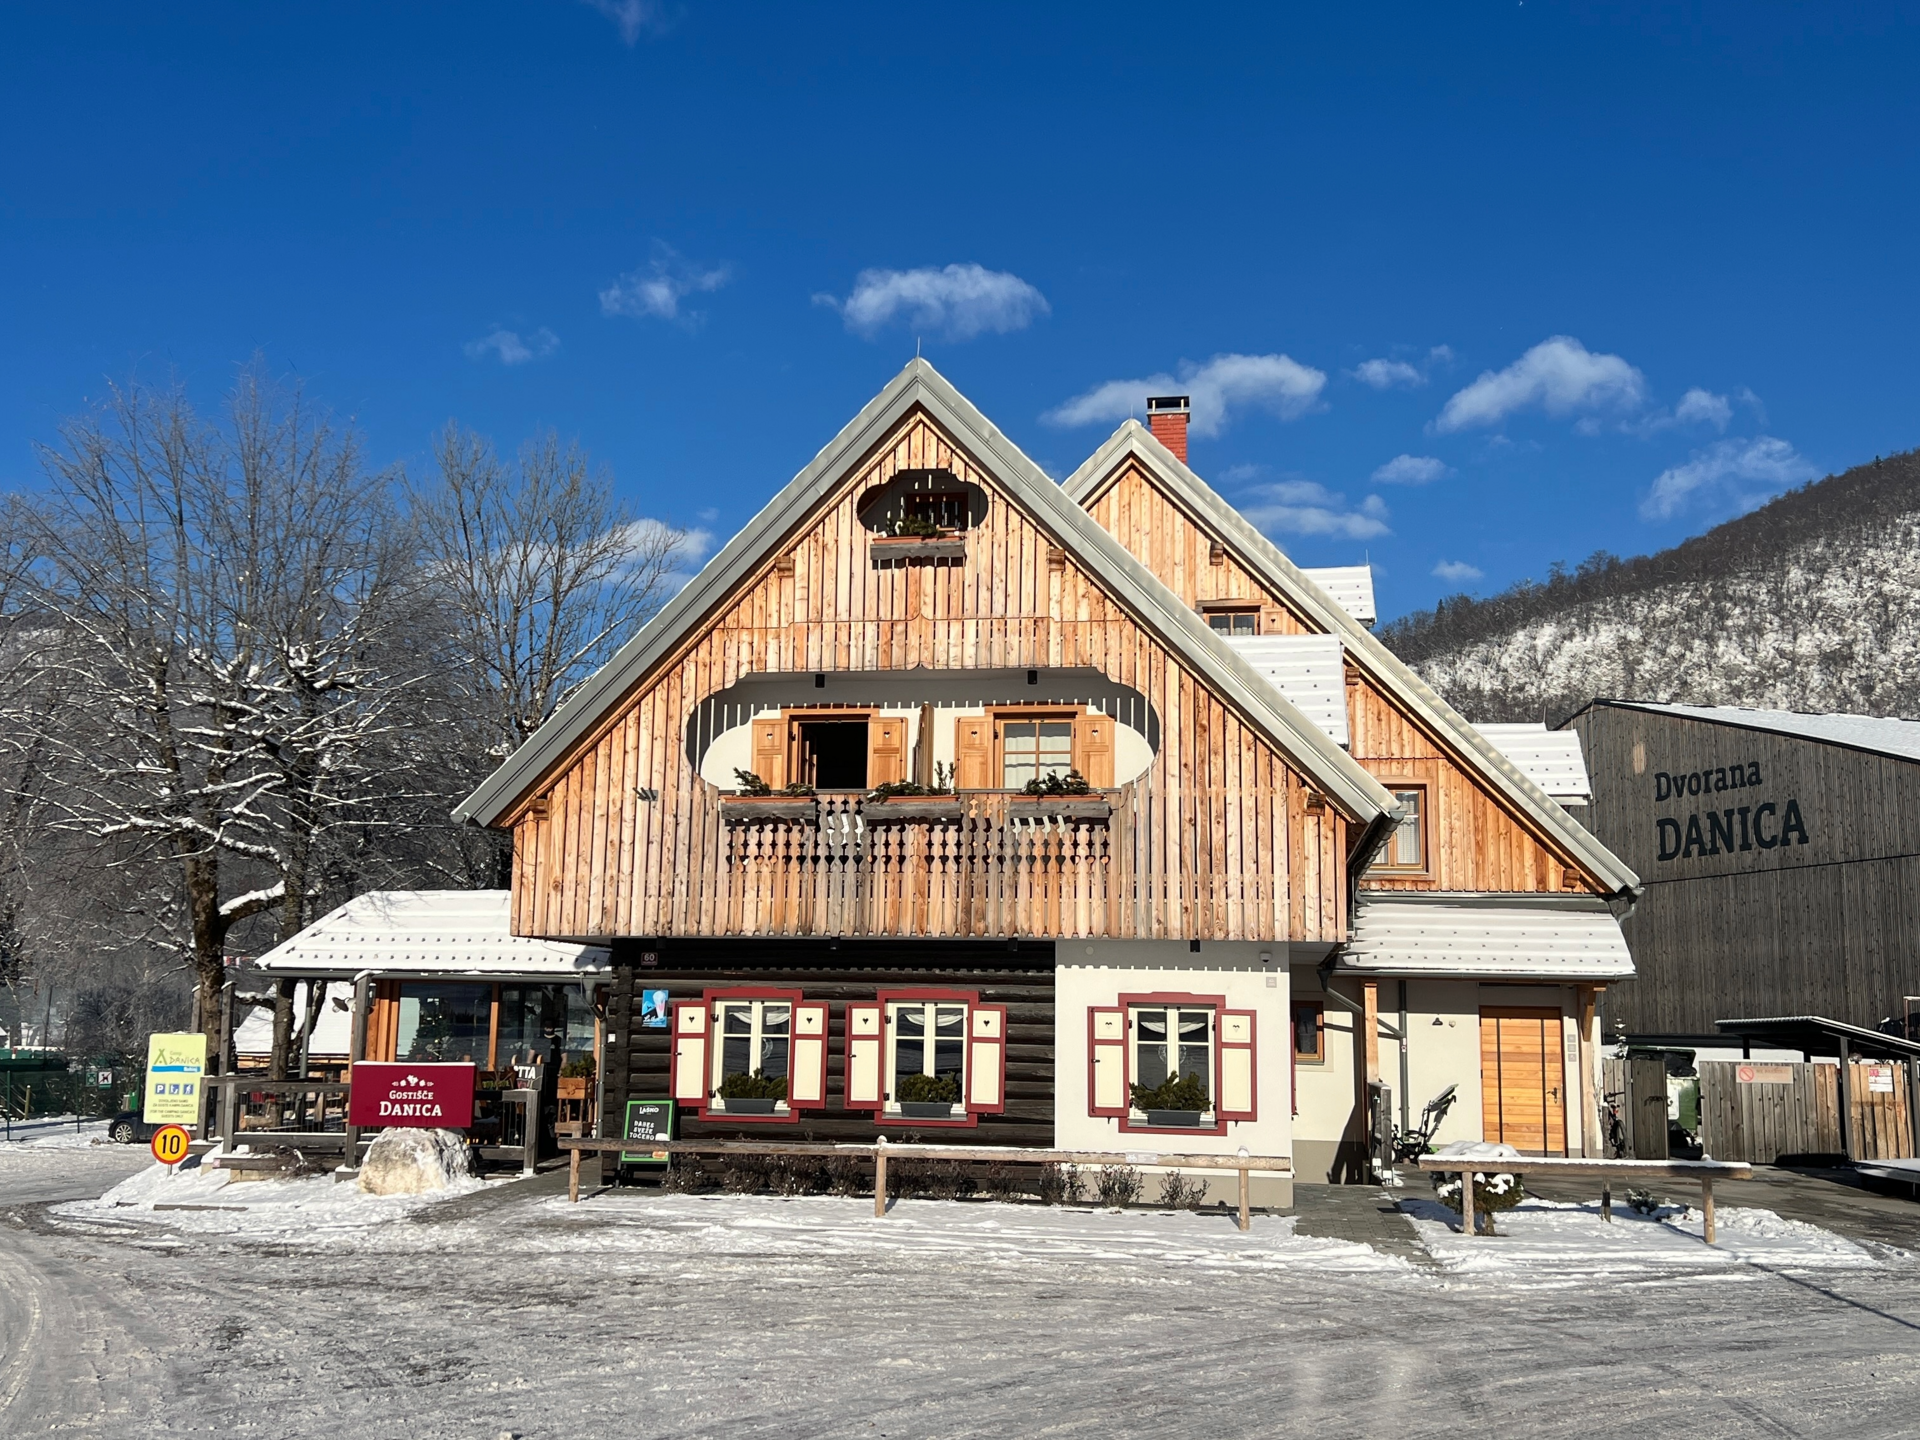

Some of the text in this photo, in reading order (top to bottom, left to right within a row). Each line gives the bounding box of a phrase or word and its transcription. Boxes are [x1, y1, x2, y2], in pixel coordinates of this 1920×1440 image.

[1655, 761, 1763, 802] Dvorana
[1656, 799, 1809, 861] DANICA
[644, 953, 655, 961] 60
[169, 1056, 200, 1065] DANICA
[378, 1101, 442, 1117] DANICA
[162, 1134, 181, 1155] 10
